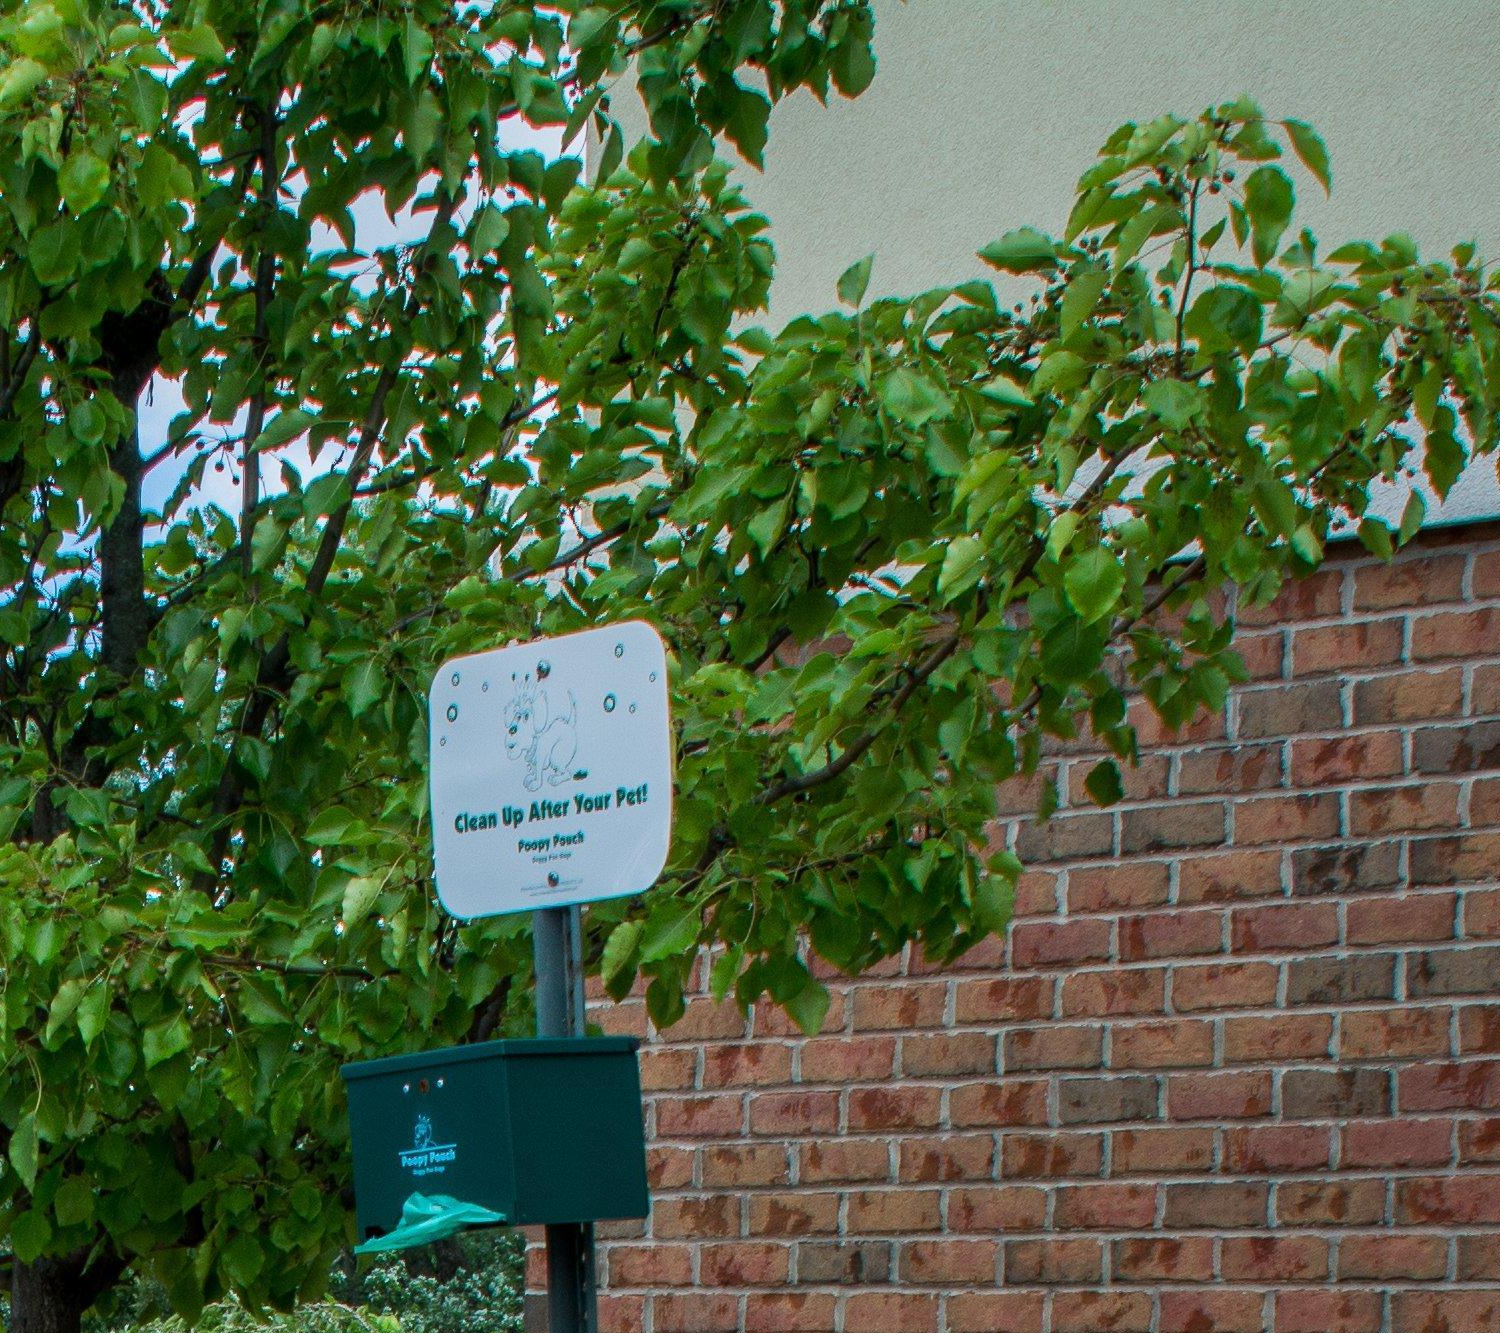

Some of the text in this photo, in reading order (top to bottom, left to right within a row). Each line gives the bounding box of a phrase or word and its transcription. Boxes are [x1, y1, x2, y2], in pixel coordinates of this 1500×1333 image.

[454, 782, 649, 834] Clean Up After Your Pet!
[518, 837, 551, 853] Poopy
